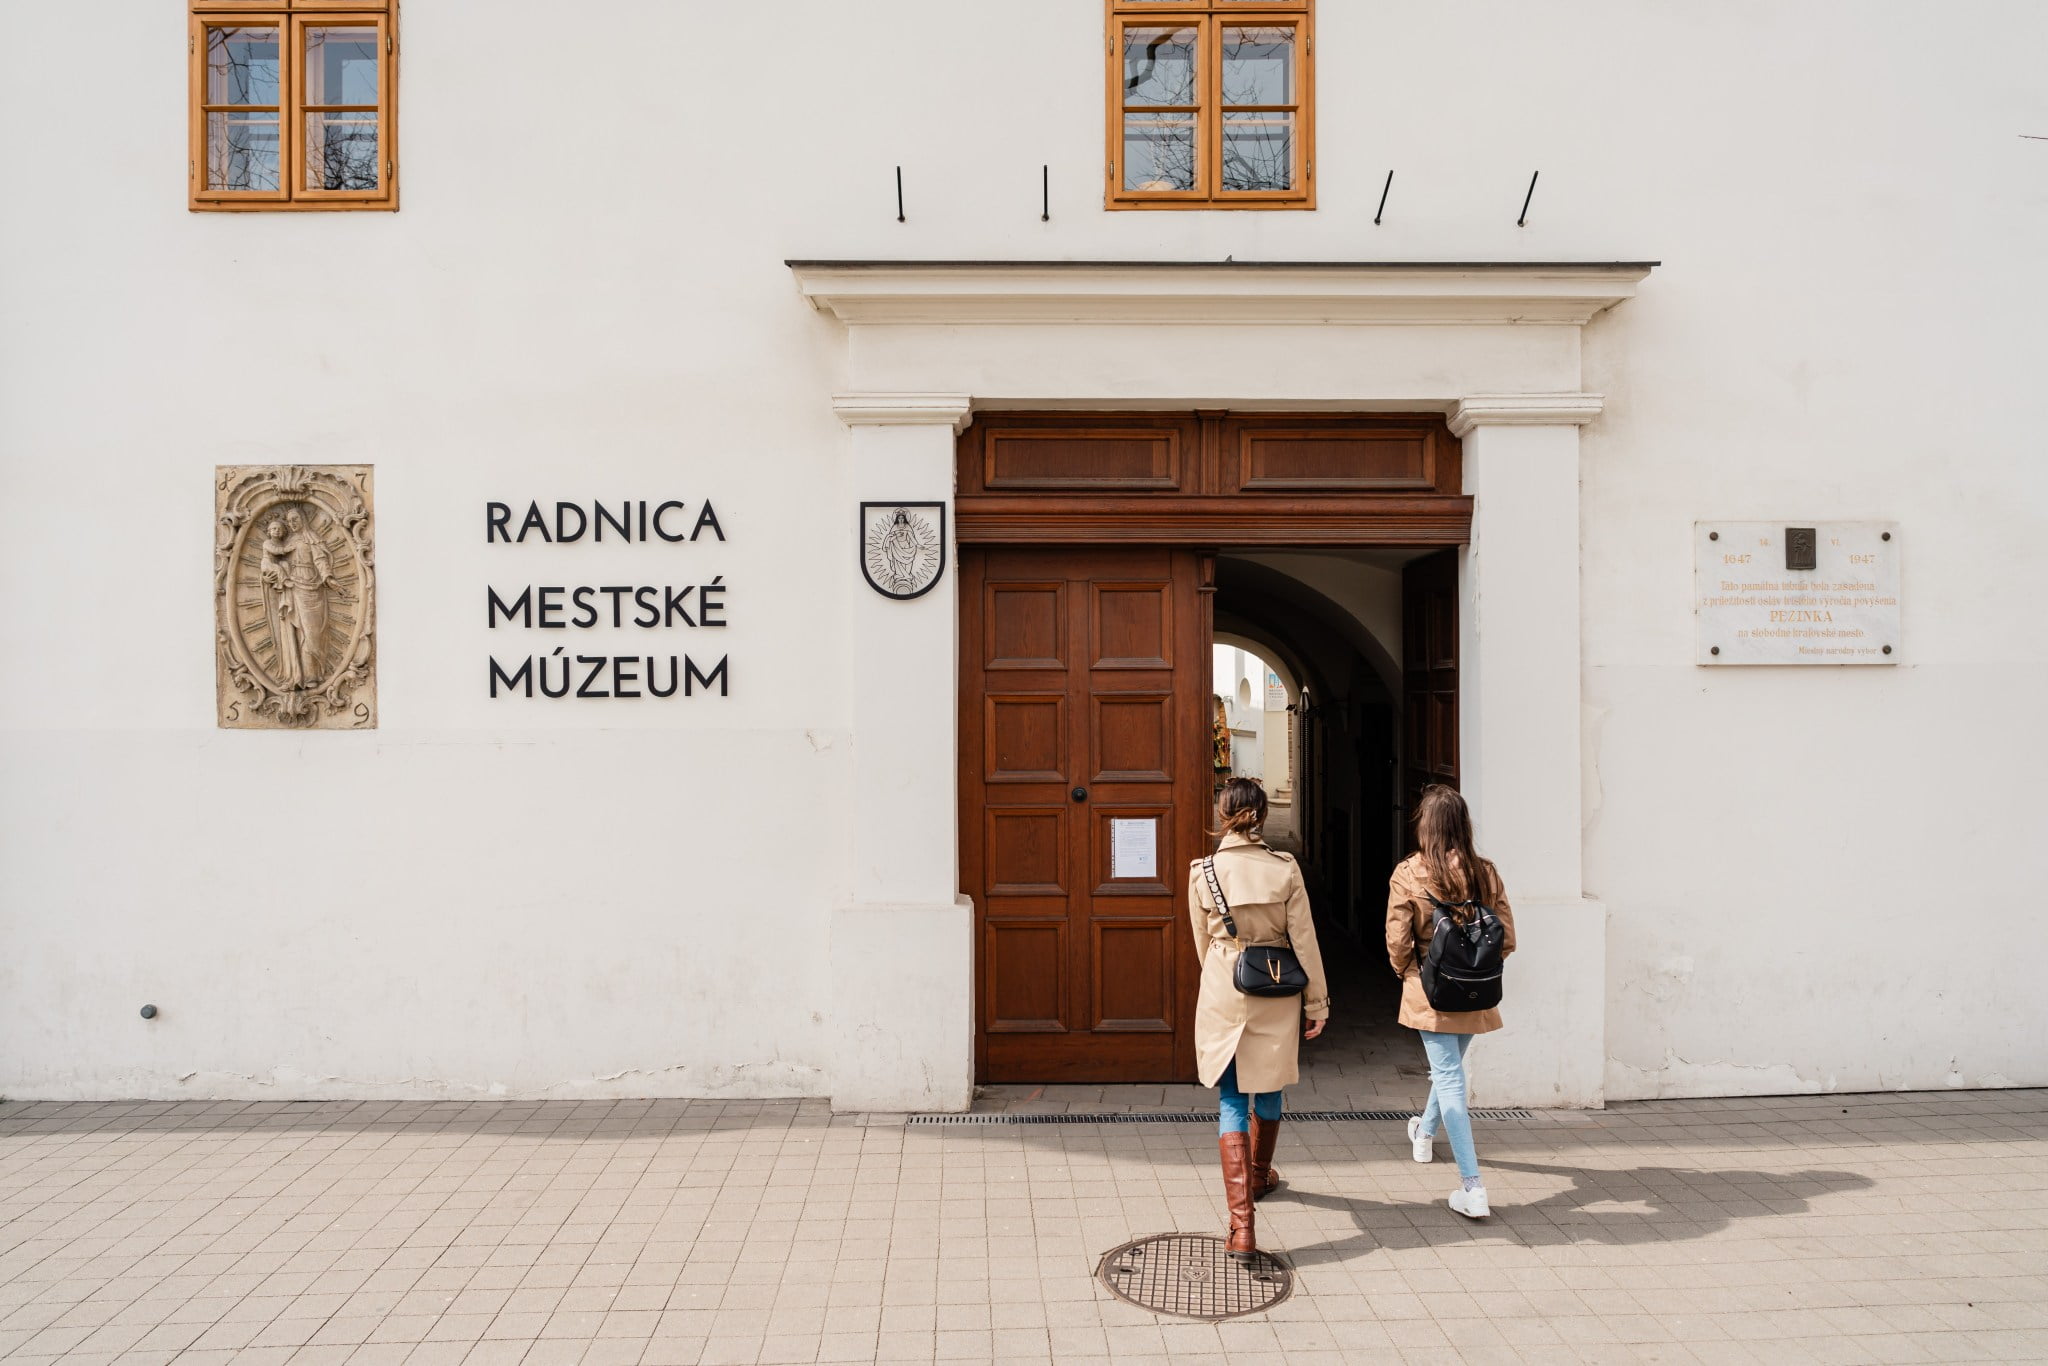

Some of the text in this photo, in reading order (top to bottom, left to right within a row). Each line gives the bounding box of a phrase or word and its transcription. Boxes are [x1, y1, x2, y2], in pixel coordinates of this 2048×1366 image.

[355, 473, 367, 492] 7
[487, 498, 726, 544] RADNICA
[1723, 554, 1875, 564] 1647 1947
[488, 575, 727, 628] MESTSKÉ
[1770, 610, 1833, 622] PEZINKA
[489, 647, 728, 698] MÚZEUM
[227, 701, 369, 726] 5 9
